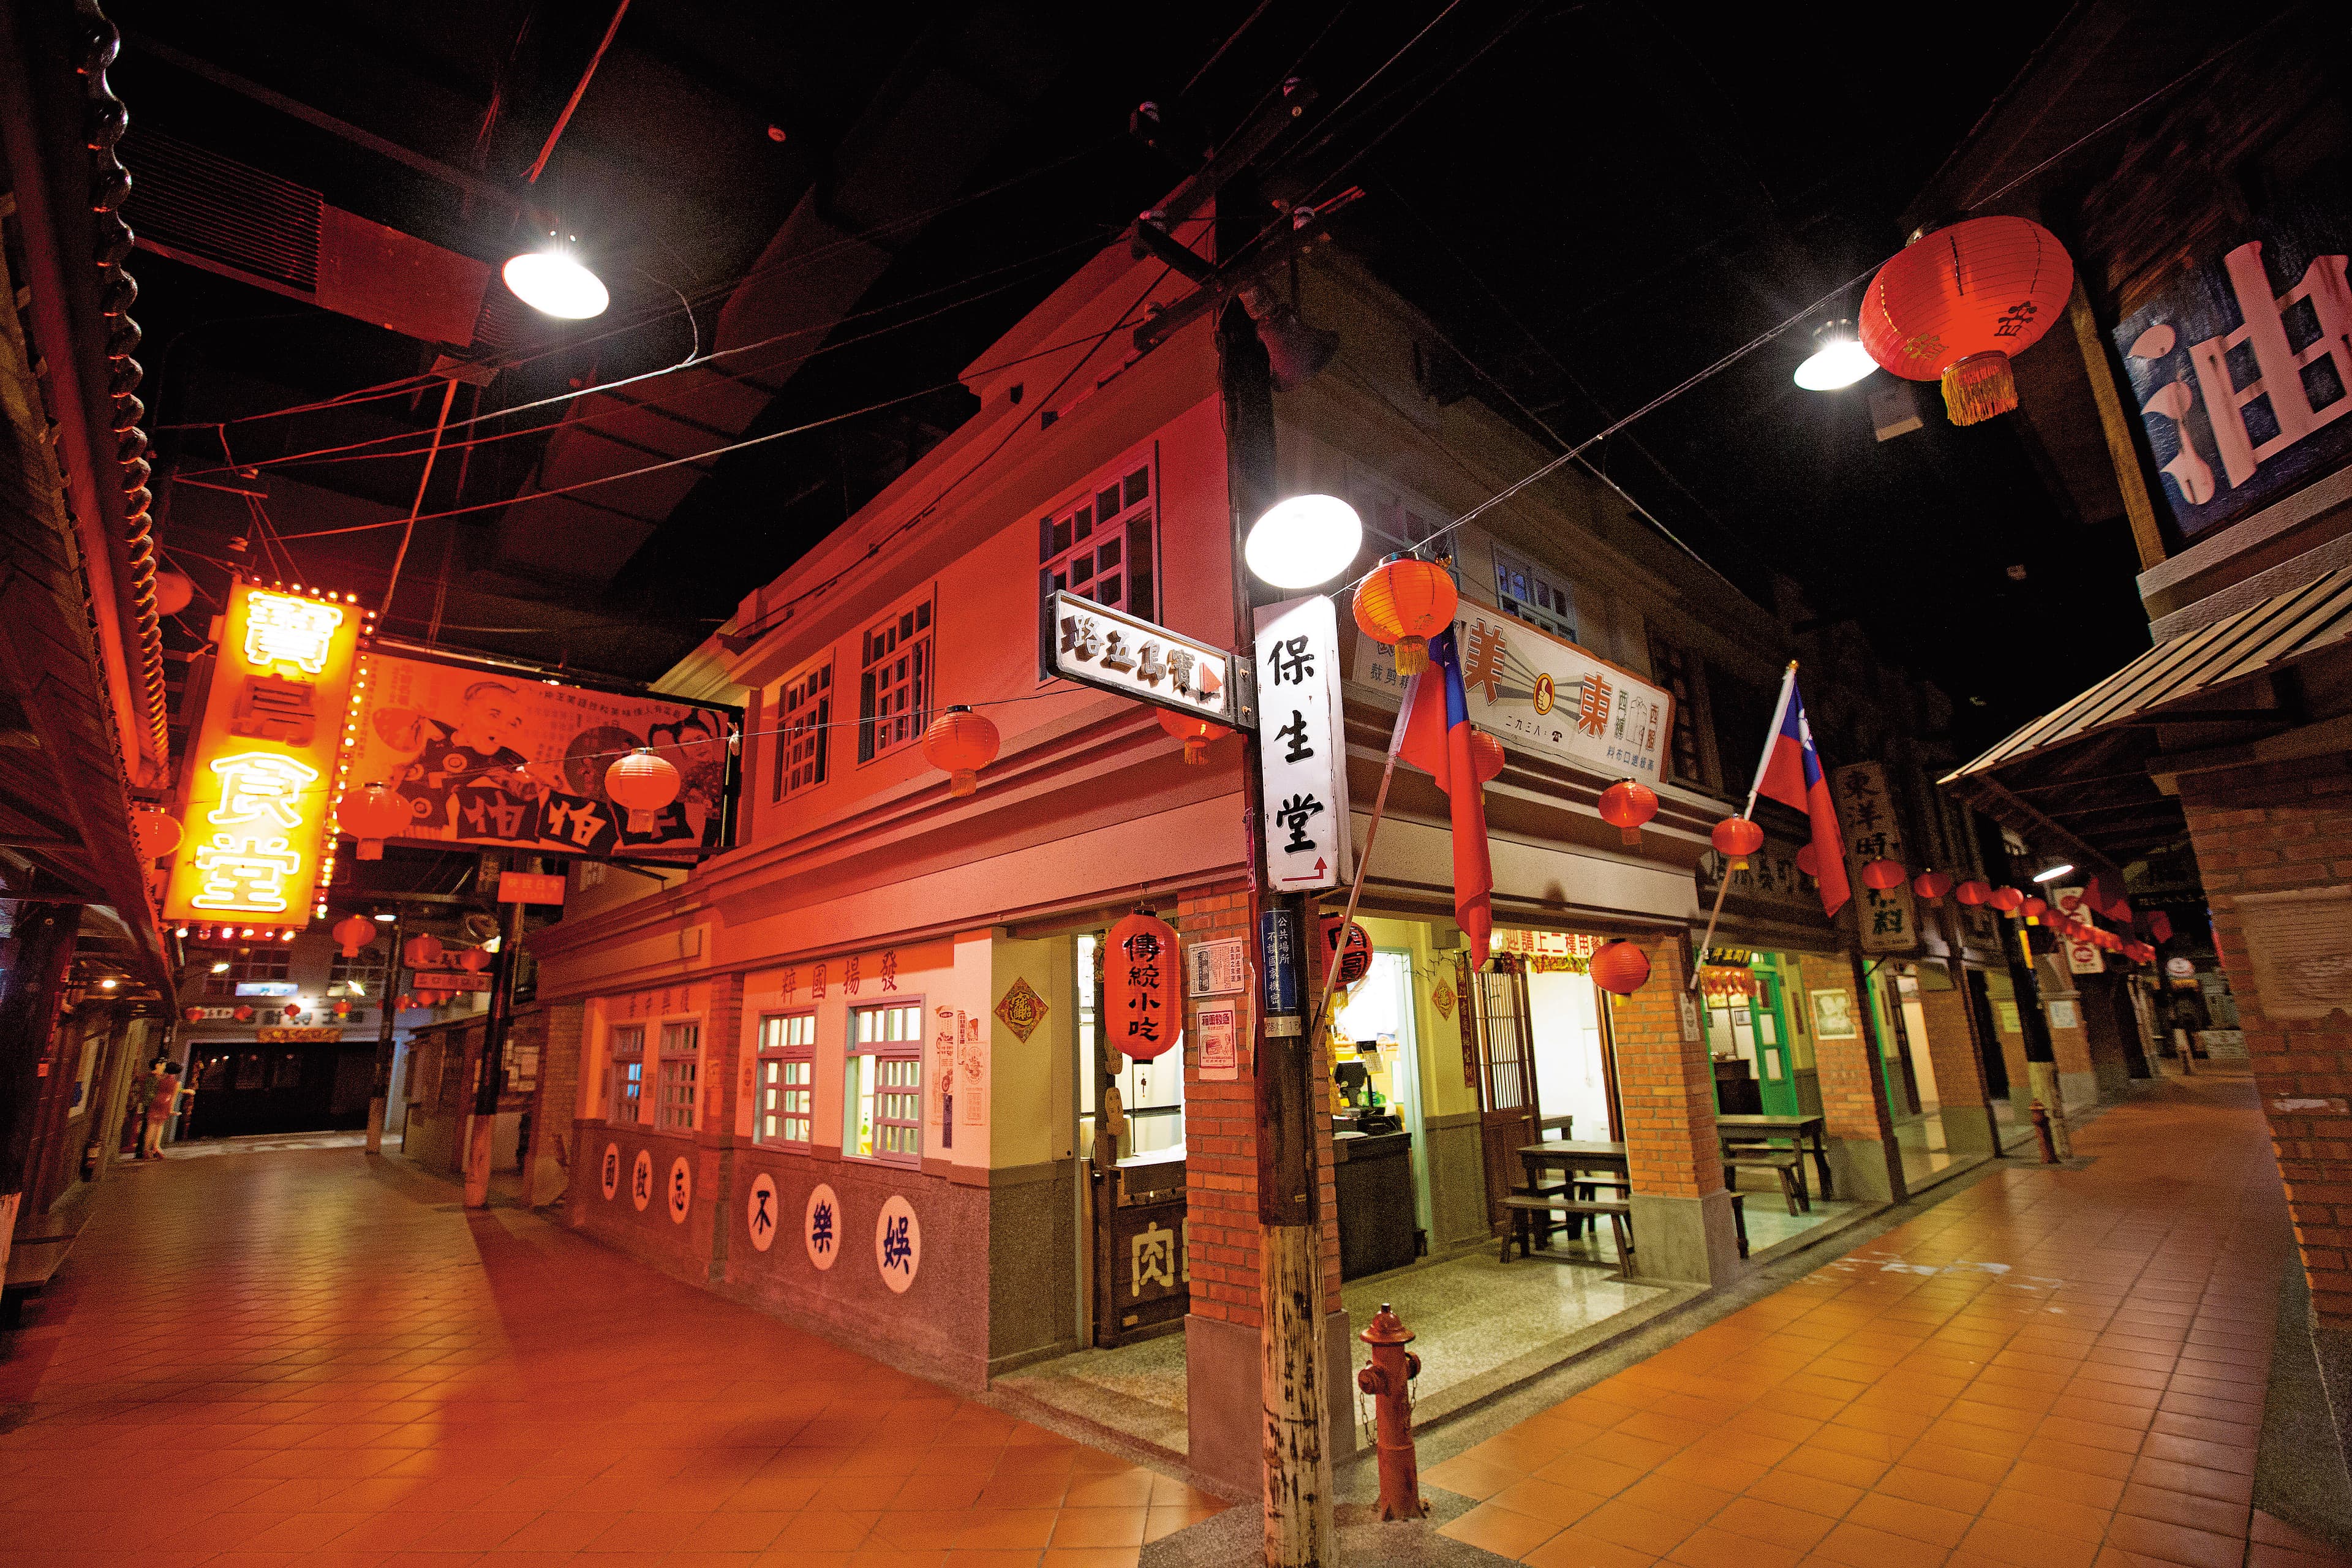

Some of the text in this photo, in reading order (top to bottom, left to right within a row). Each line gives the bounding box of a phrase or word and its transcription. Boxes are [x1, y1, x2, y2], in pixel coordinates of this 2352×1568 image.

[2127, 239, 2352, 506] 油
[1267, 634, 1325, 854] 保生堂
[781, 949, 898, 1006] 發揚國粹
[1266, 931, 1281, 1005] 不談國家機密
[1278, 916, 1290, 965] 公共場所
[1123, 932, 1161, 1042] 傳統小吃
